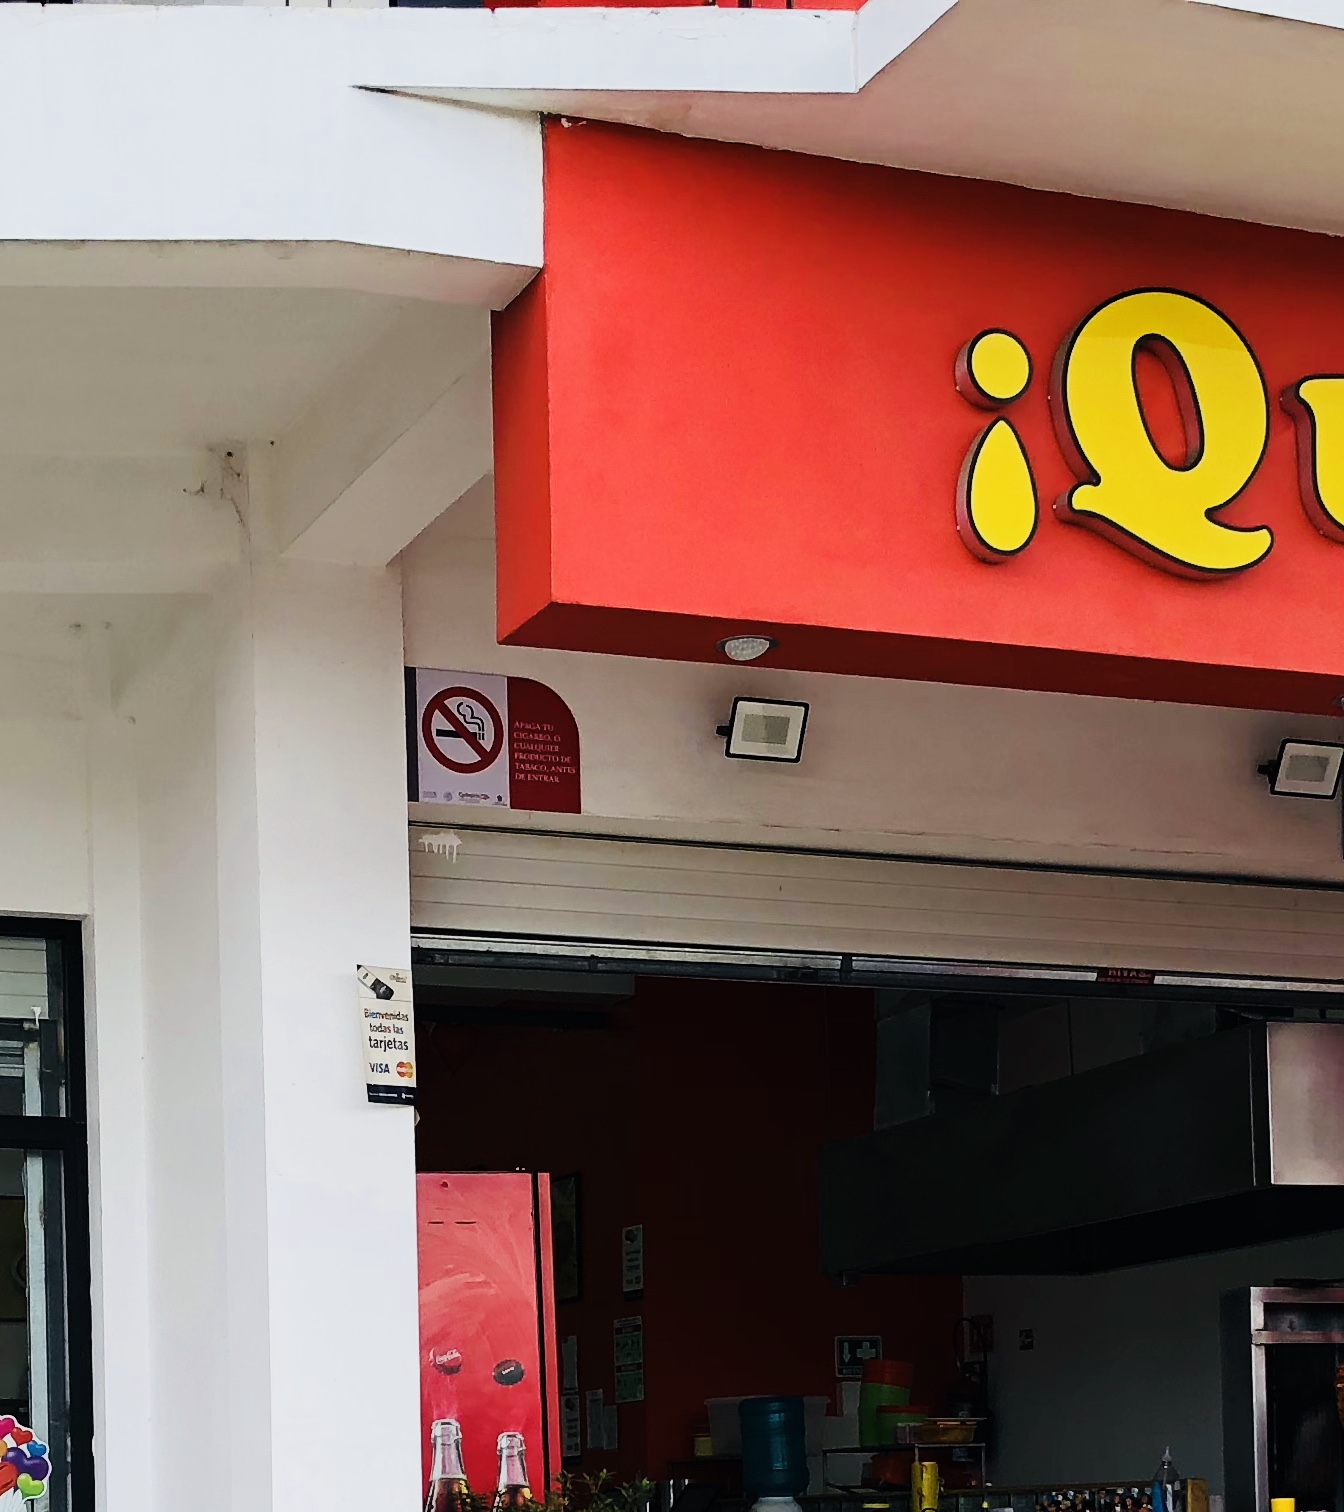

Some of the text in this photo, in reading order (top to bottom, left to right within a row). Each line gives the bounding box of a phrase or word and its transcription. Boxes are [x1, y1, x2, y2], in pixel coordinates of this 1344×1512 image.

[513, 721, 541, 730] APAGA
[513, 742, 559, 752] CUALQUIER
[514, 752, 559, 762] PRODUCTO
[551, 766, 576, 774] ANTES
[515, 772, 560, 783] DE ENTRAR
[363, 1007, 409, 1021] Bienvenidas
[369, 1023, 404, 1034] todas las
[368, 1035, 409, 1052] tarjetas
[368, 1062, 390, 1074] VISA
